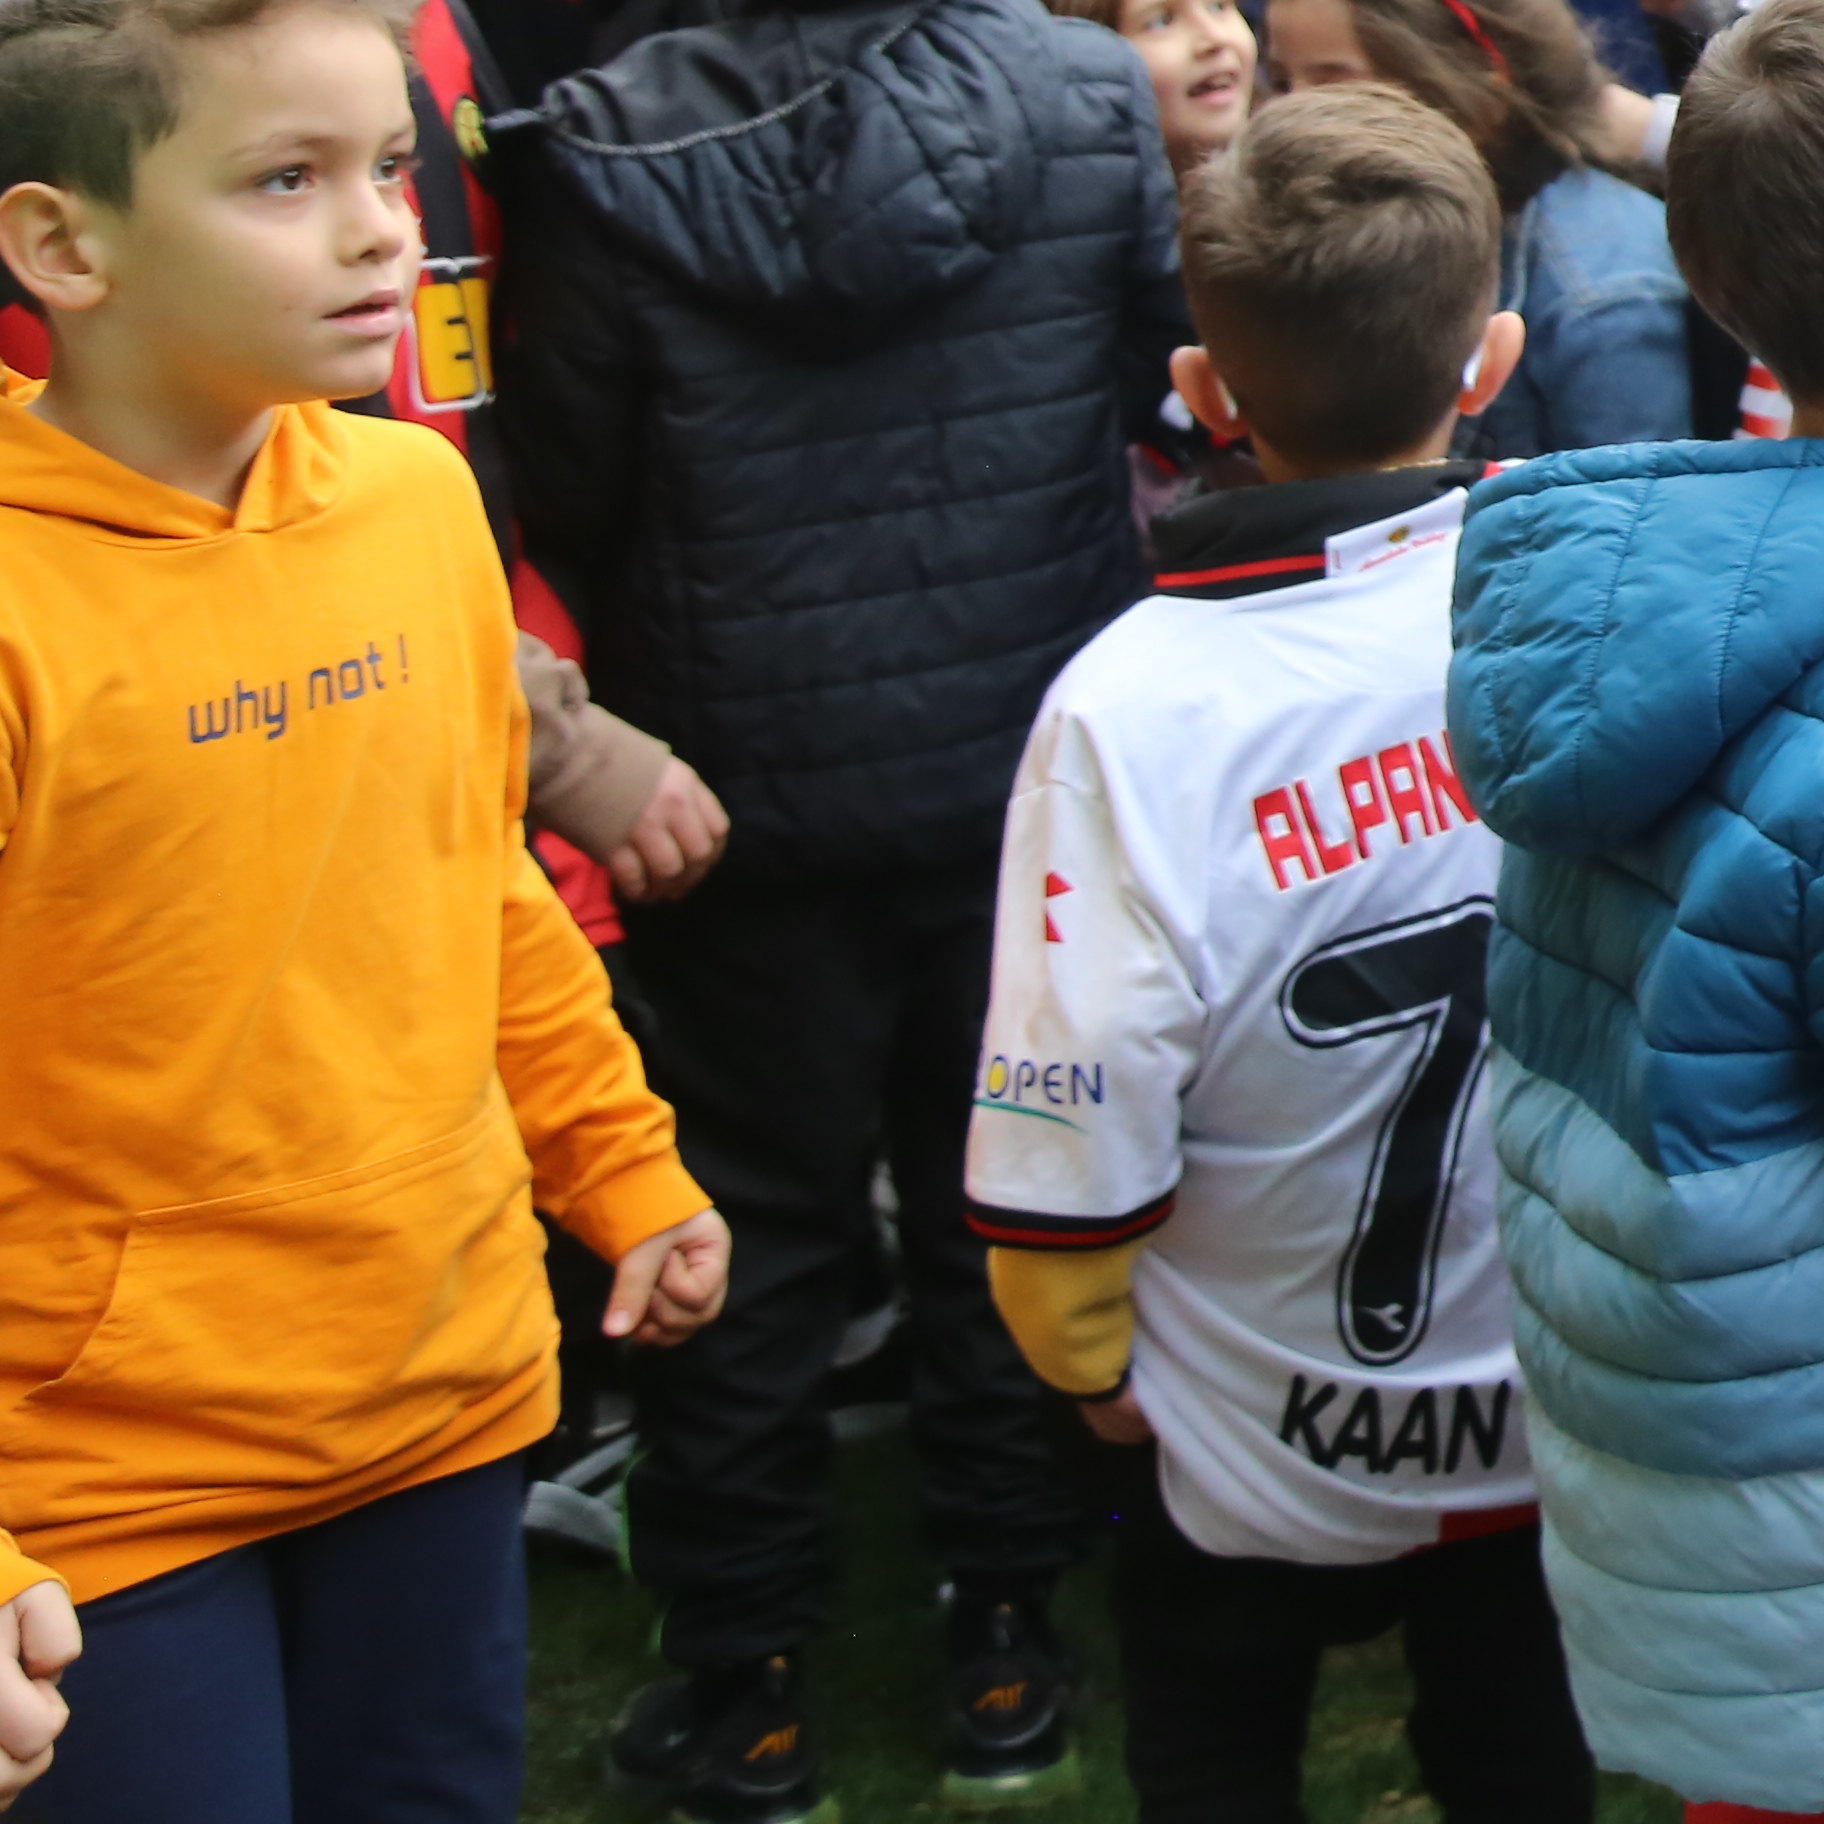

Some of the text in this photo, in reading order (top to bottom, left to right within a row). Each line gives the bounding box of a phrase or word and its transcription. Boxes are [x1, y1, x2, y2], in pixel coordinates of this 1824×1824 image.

[187, 678, 288, 745] why
[308, 640, 387, 711] not
[986, 1054, 1106, 1105] OPEN
[1277, 894, 1497, 1366] 7
[1279, 1374, 1511, 1477] KAAN
